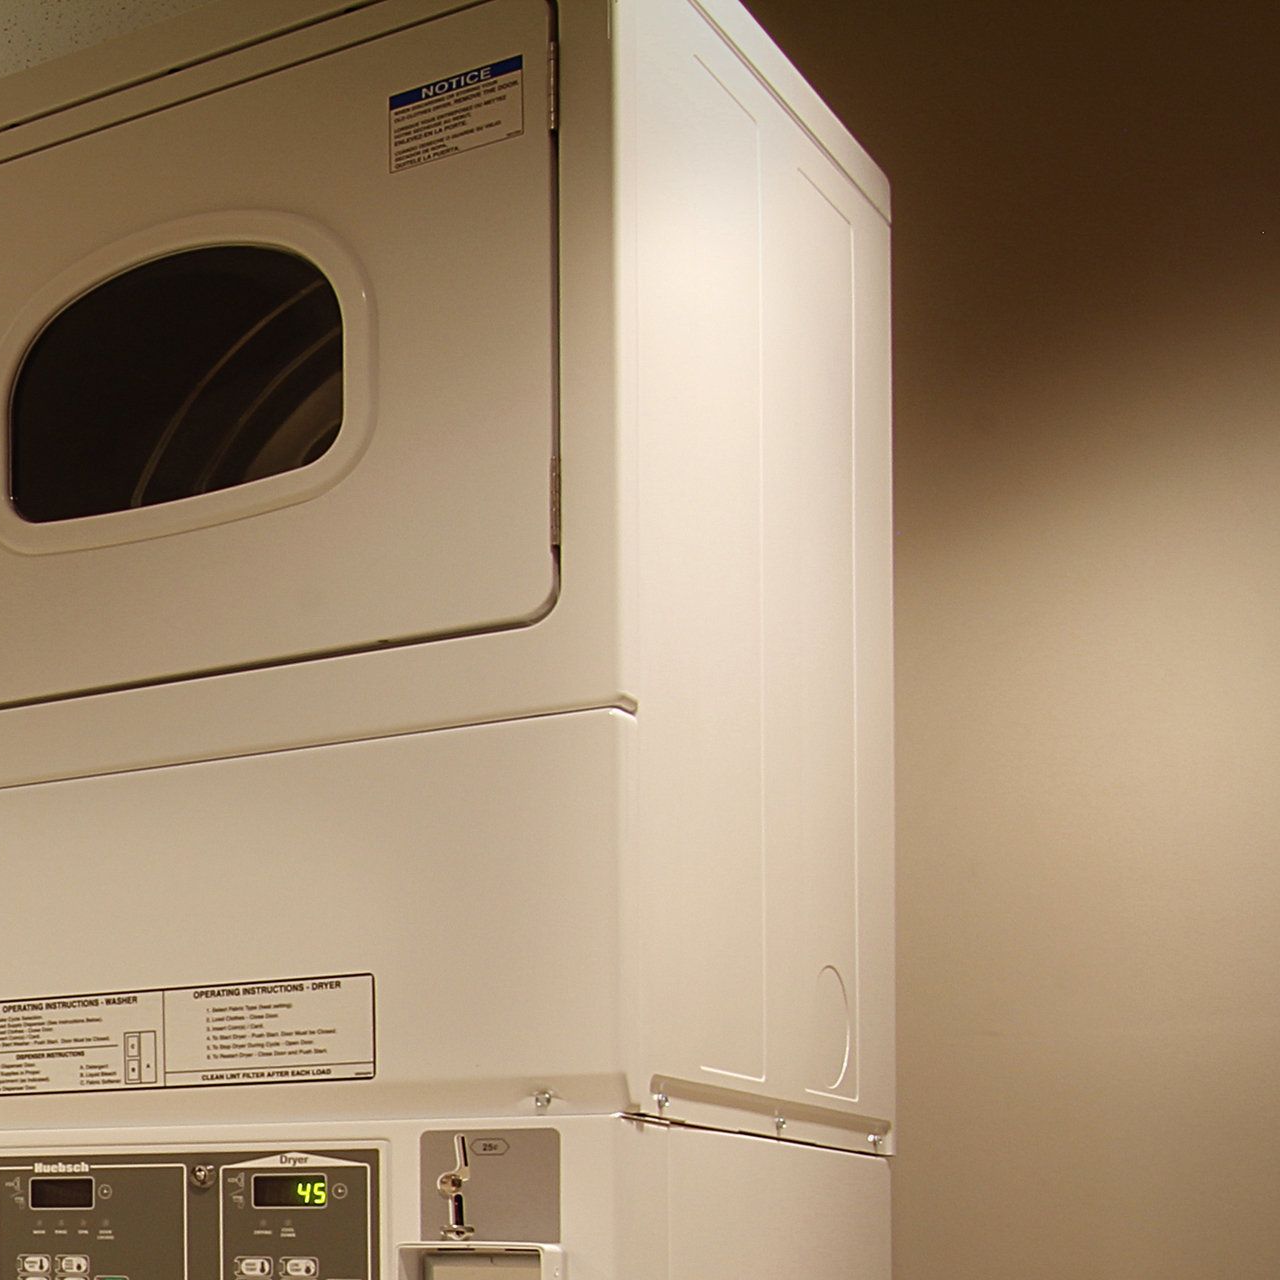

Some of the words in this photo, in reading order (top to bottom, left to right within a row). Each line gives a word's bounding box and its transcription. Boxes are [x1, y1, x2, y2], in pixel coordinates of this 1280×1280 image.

[422, 67, 491, 98] NOTICE
[484, 86, 495, 94] THE
[193, 988, 240, 999] OPERATING
[242, 984, 304, 995] INSTRUCTIONS
[312, 981, 341, 990] DRYER
[2, 1003, 43, 1013] OPERATING
[45, 999, 98, 1010] INSTRUCTIONS
[106, 996, 137, 1005] WASHER
[34, 1162, 89, 1173] Huebsch
[280, 1155, 308, 1166] Dryer
[297, 1182, 326, 1204] 45
